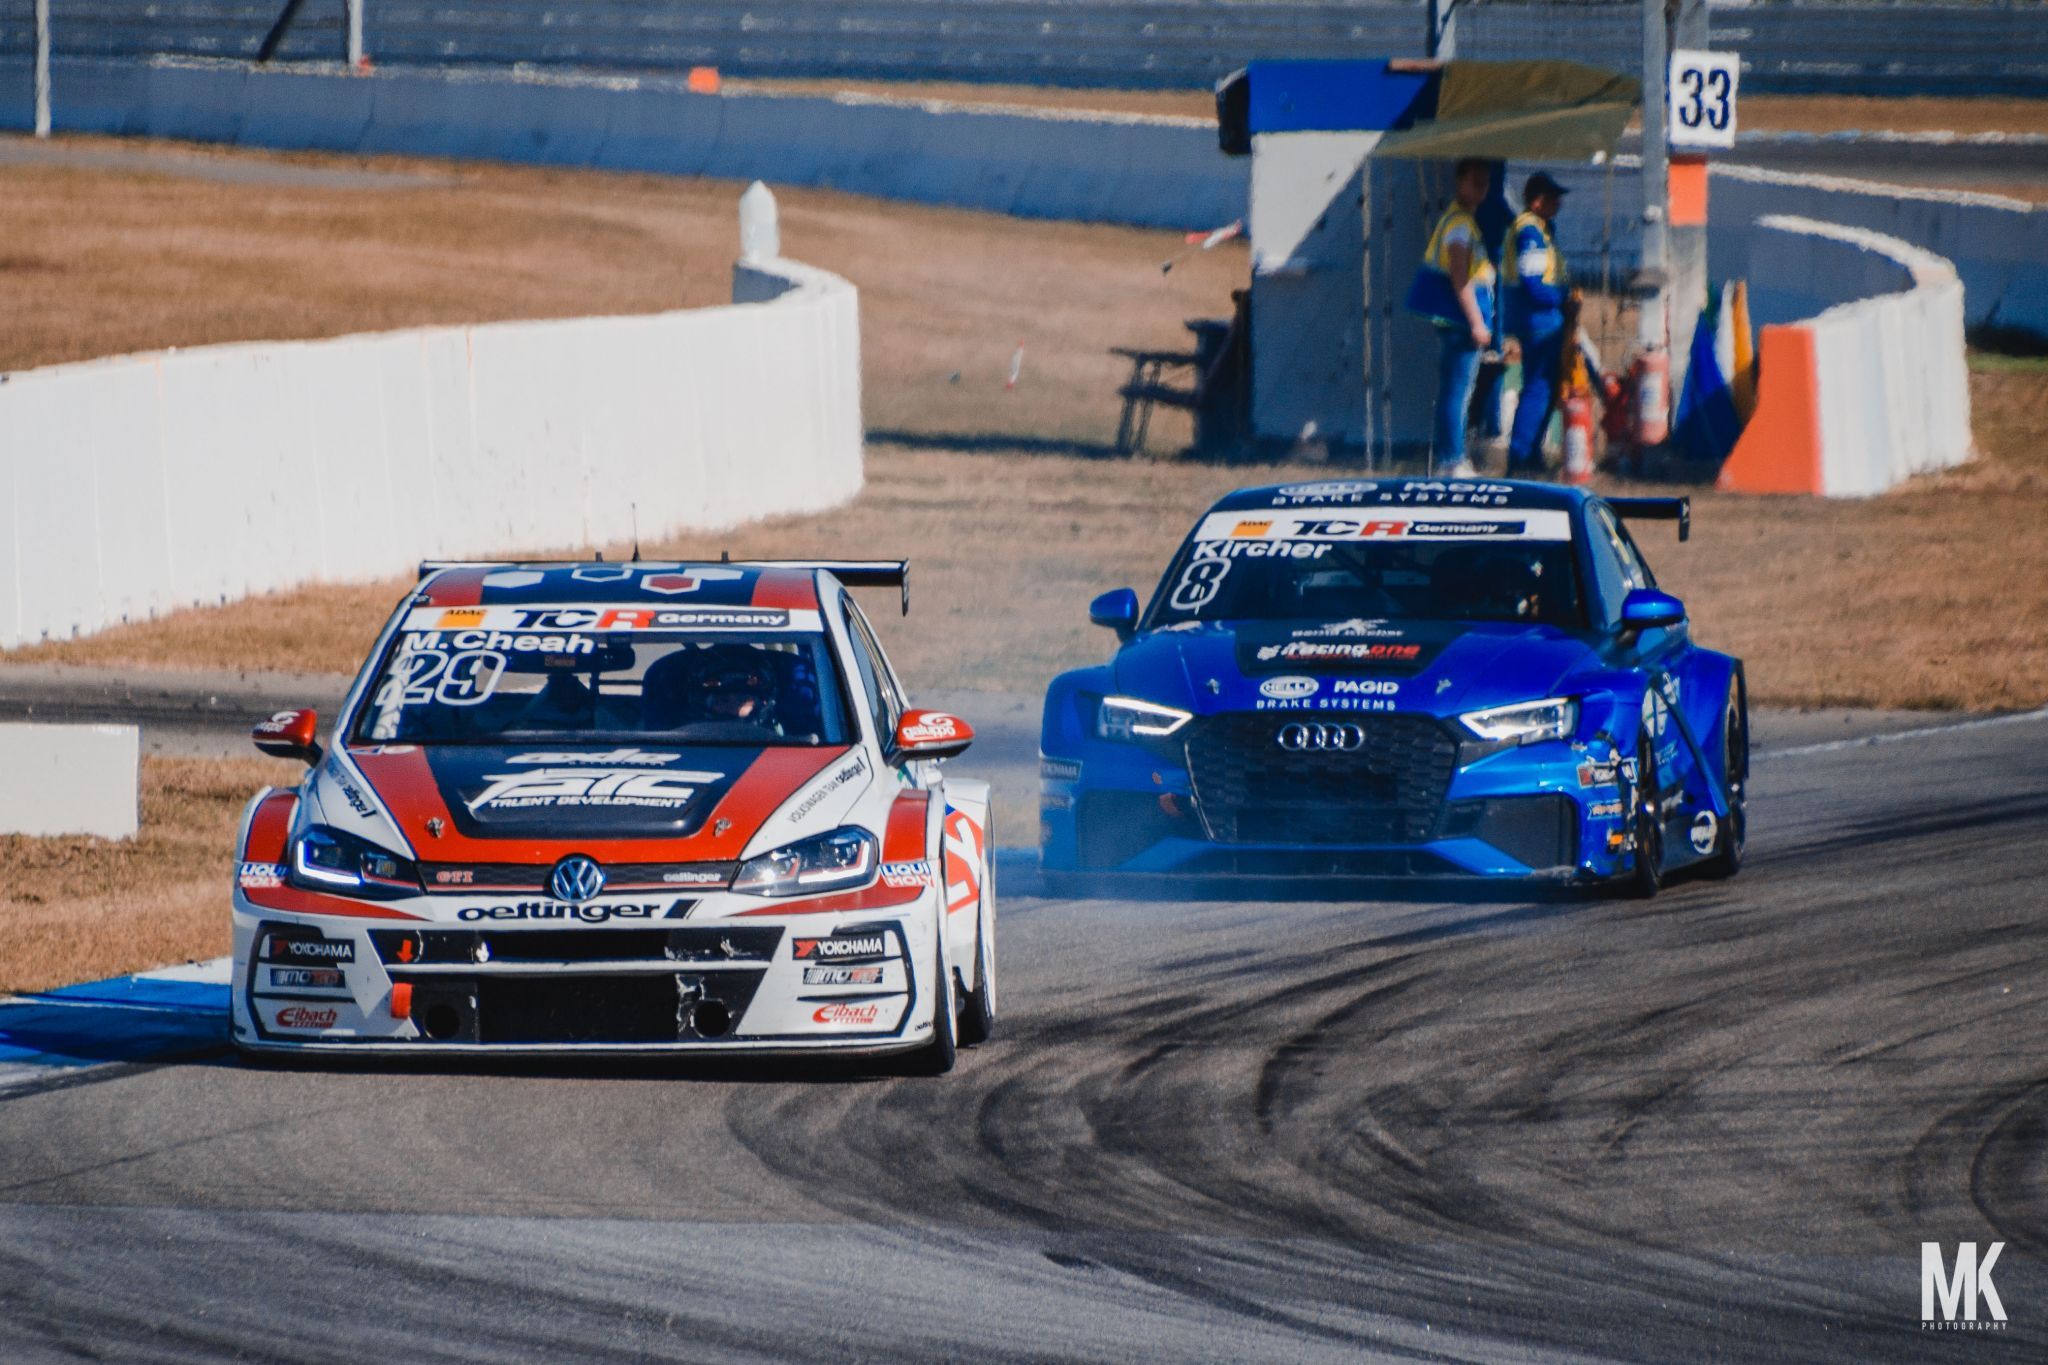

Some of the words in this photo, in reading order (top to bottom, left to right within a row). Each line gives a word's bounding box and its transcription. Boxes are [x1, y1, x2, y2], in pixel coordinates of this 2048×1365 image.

[1680, 69, 1730, 130] 33
[1293, 520, 1410, 536] TCR
[1415, 524, 1499, 535] Germany
[1193, 540, 1333, 560] Kircher
[1170, 556, 1232, 610] 8
[514, 608, 655, 629] TCR
[657, 612, 785, 625] Germany
[1335, 680, 1399, 694] PAGID
[1257, 699, 1311, 710] BRAKE
[1320, 699, 1395, 711] SYSTEMS
[489, 795, 556, 808] TALENT
[557, 796, 688, 808] DEVELOPMENT
[436, 870, 474, 884] GTI
[881, 863, 932, 876] LIQUI
[886, 875, 936, 888] MOLY
[456, 901, 660, 923] oettinger
[288, 942, 352, 957] YOKOHAMA
[817, 937, 882, 955] YOKOHAMA
[276, 1007, 337, 1028] Eibach
[812, 1003, 878, 1023] Eibach
